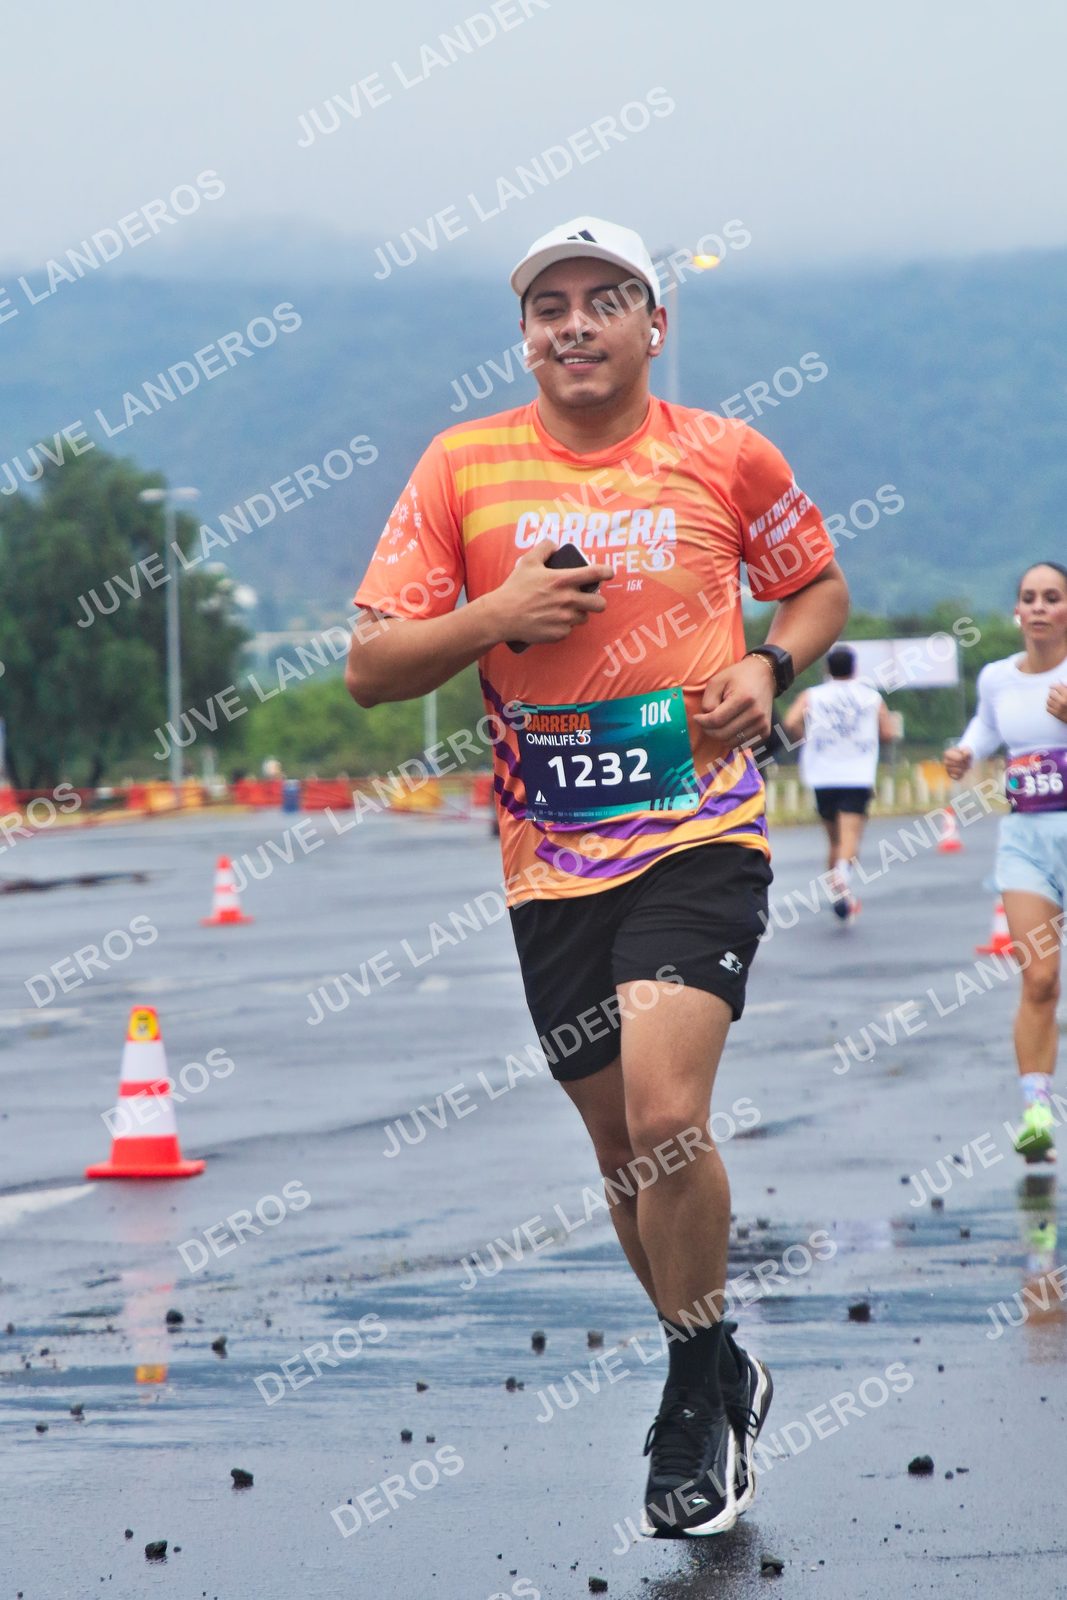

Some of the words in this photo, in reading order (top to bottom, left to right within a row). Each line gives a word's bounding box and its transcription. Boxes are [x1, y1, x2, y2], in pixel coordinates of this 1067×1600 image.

[515, 508, 677, 549] CARRERA
[525, 712, 591, 733] CARRERA
[640, 698, 672, 727] 10K
[548, 748, 651, 788] 1232
